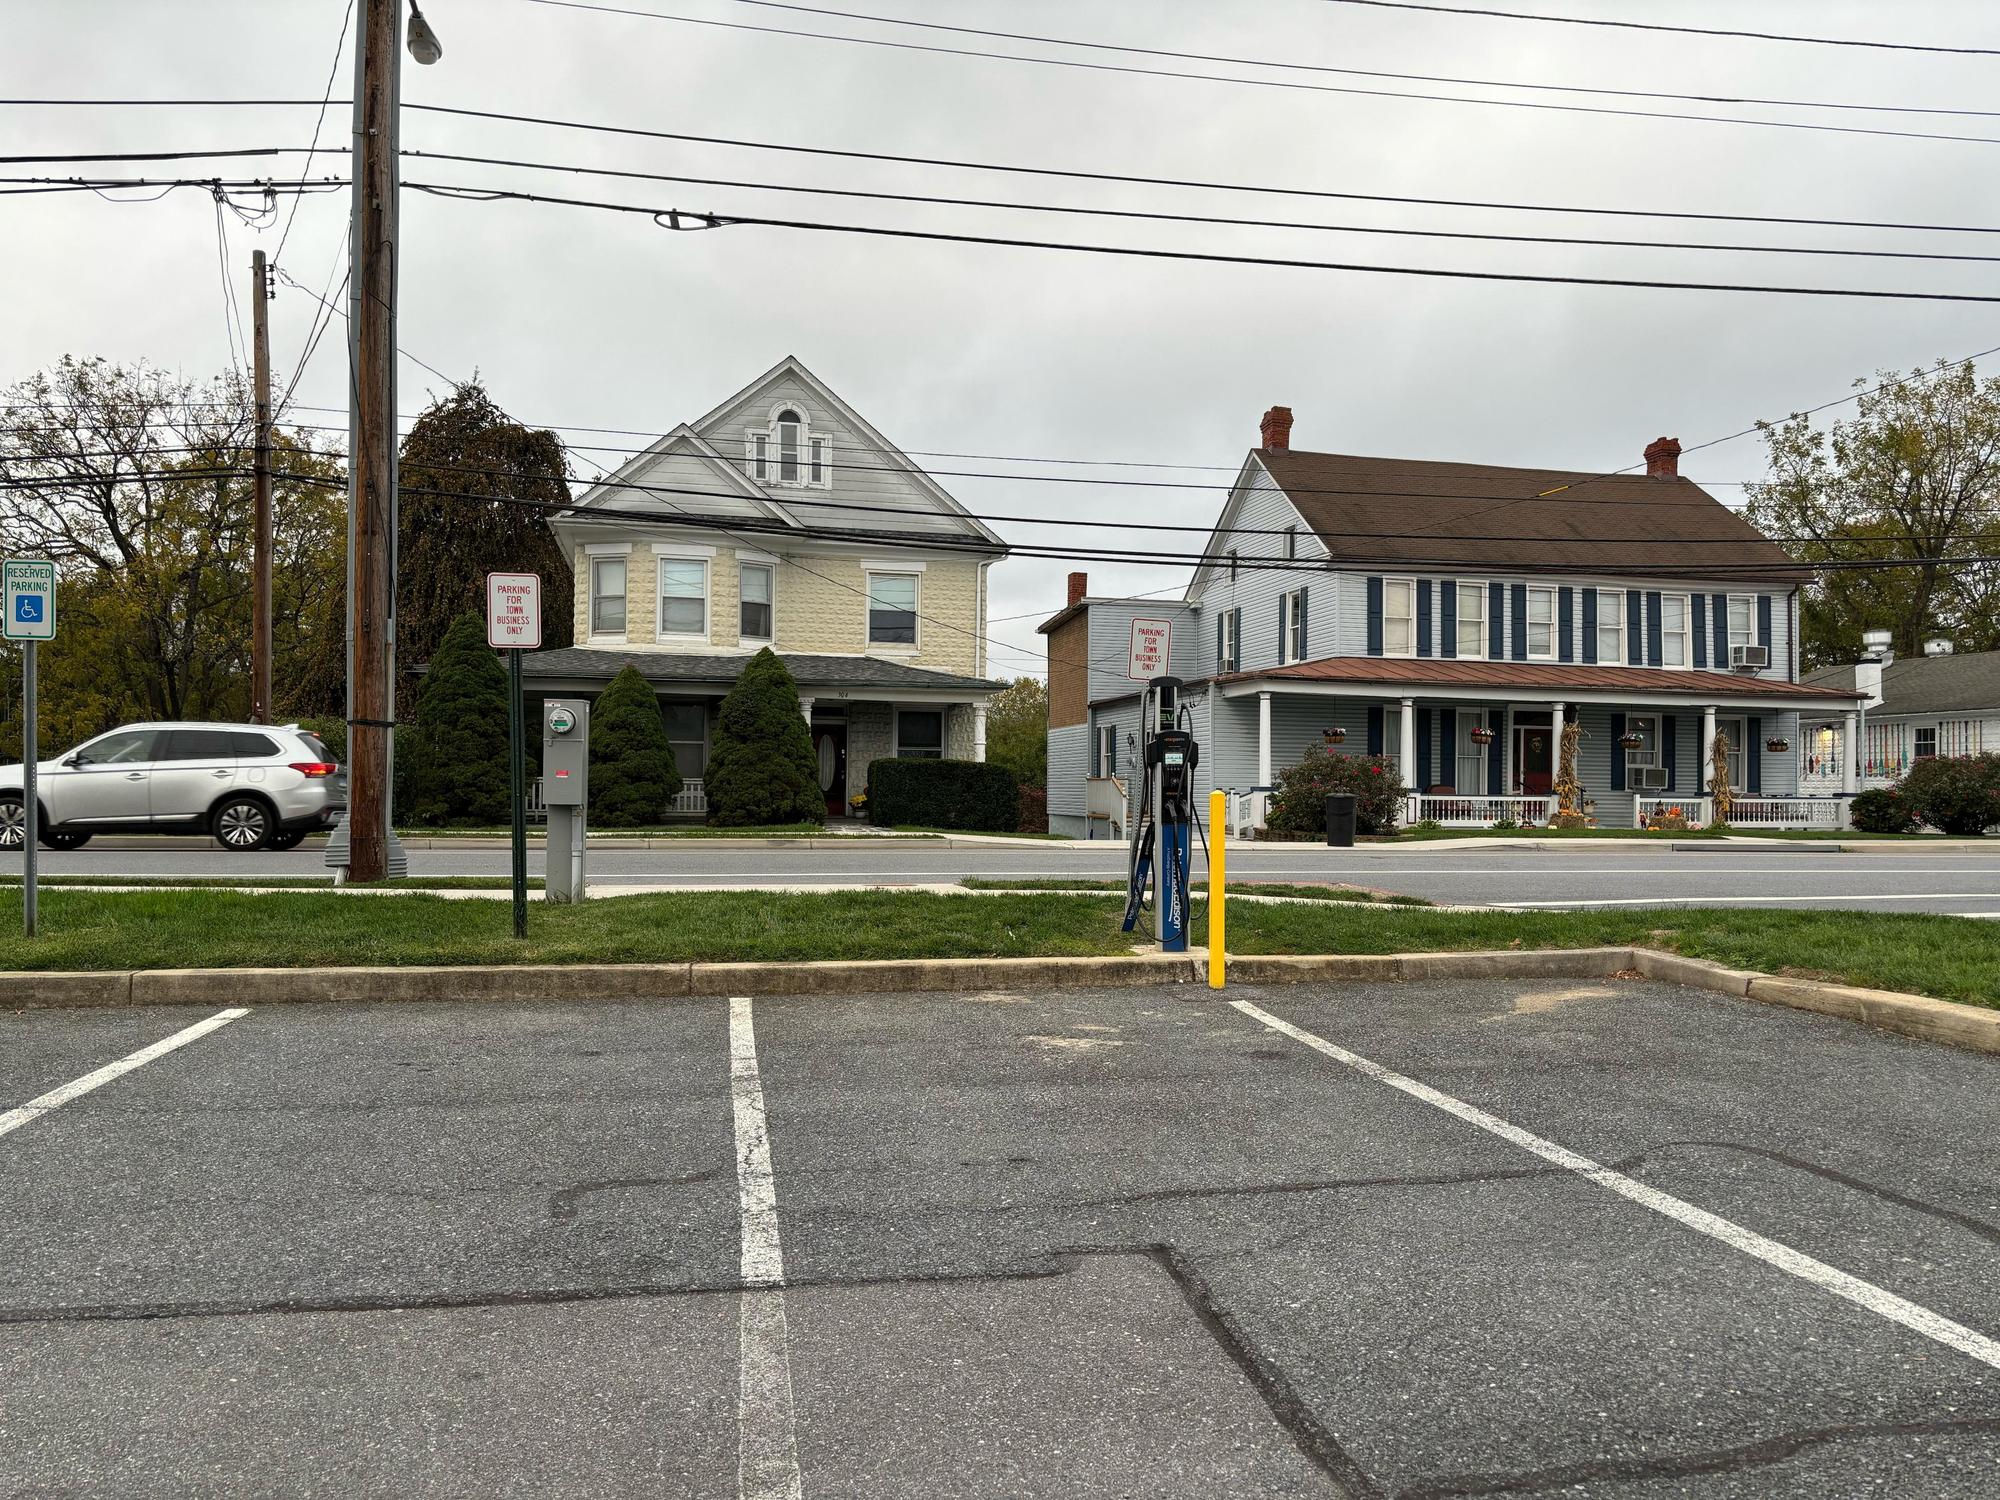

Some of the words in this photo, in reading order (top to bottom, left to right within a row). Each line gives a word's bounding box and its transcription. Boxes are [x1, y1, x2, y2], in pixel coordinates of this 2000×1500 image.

[8, 568, 51, 578] RESERVED
[11, 582, 48, 592] PARKING
[497, 585, 531, 595] PARKING
[506, 596, 522, 604] FOR
[506, 606, 523, 614] TOWN
[496, 616, 530, 625] BUSINESS
[506, 626, 523, 635] ONLY
[1138, 628, 1165, 637] PARKING
[1144, 637, 1157, 645] FOR
[1143, 646, 1158, 654] TOWN
[1135, 654, 1162, 663] BUSINESS
[1142, 663, 1155, 671] ONLY
